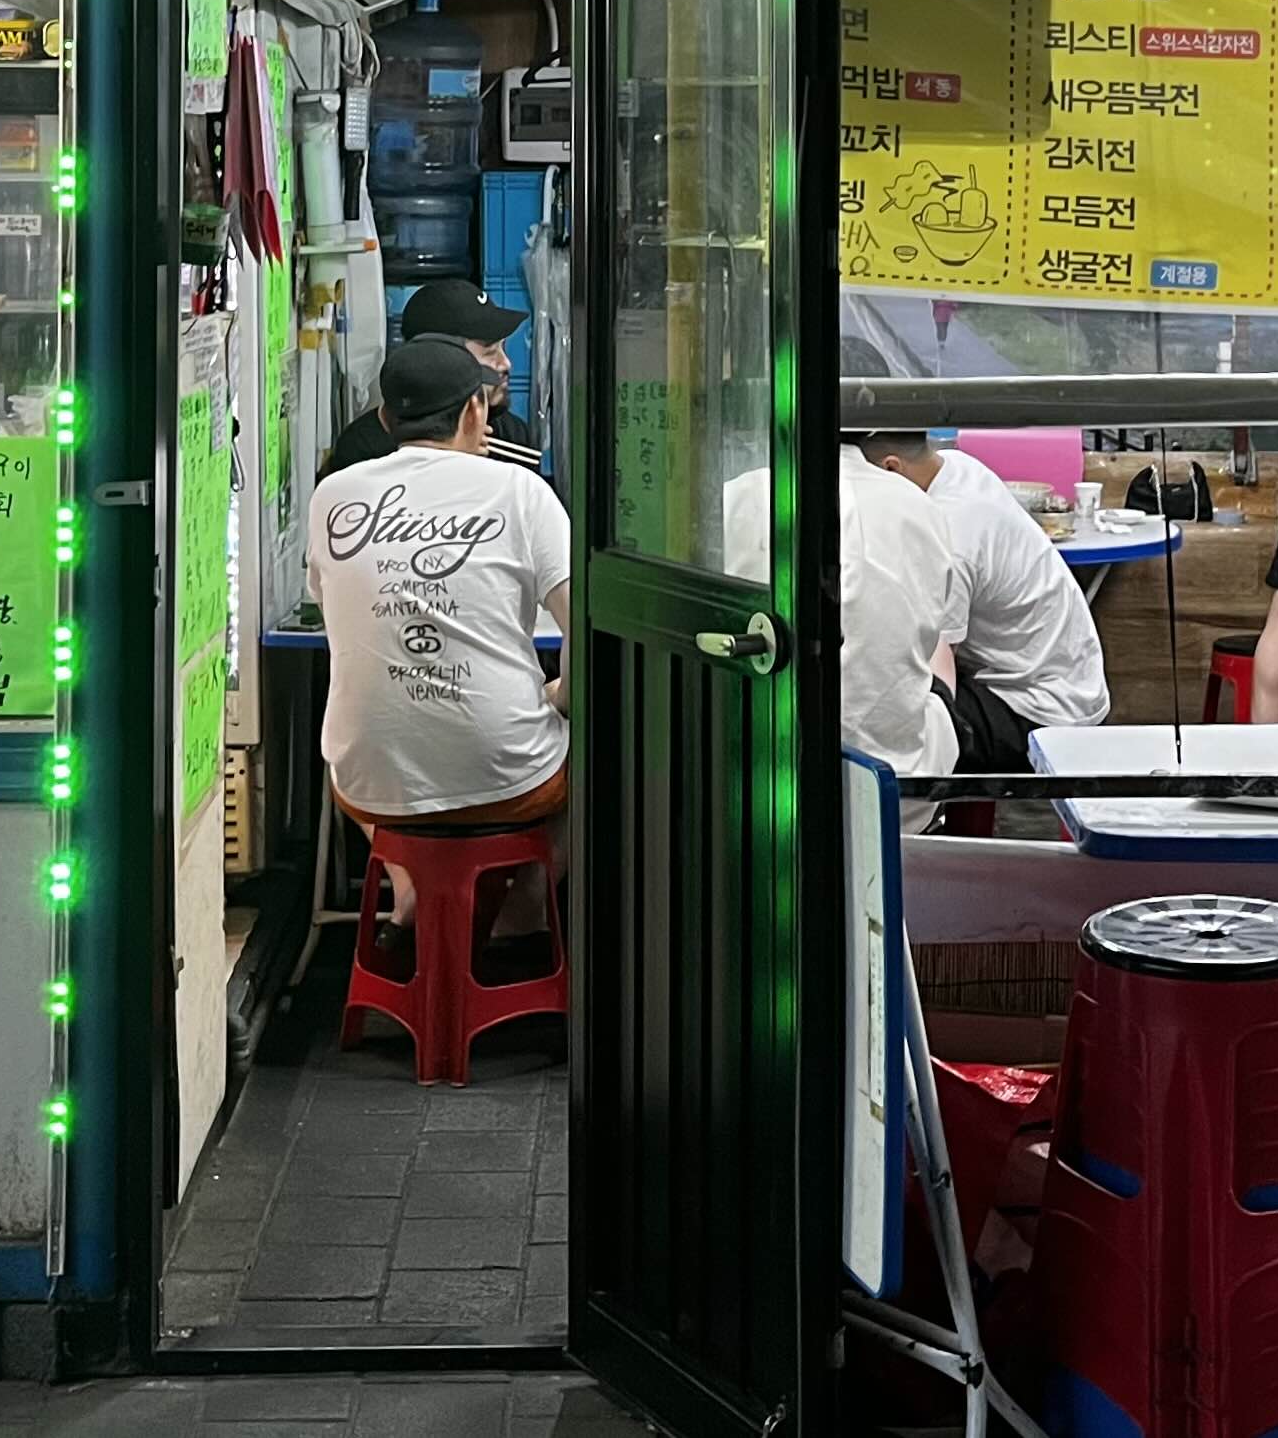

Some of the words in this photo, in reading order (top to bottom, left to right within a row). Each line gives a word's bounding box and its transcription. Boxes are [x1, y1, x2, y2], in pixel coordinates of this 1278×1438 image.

[1043, 21, 1136, 57] 뢰스티
[1145, 32, 1255, 55] 스위스식감자전
[1041, 79, 1199, 117] 새우뜸북전
[1043, 137, 1136, 172] 김치전
[1038, 194, 1136, 230] 모듬전
[1037, 248, 1133, 286] 생굴전
[1160, 263, 1207, 286] 계절용
[379, 580, 448, 598] COMPTON
[372, 600, 421, 618] SANTA
[425, 599, 459, 617] ANA
[387, 661, 472, 681] BROOKLYN
